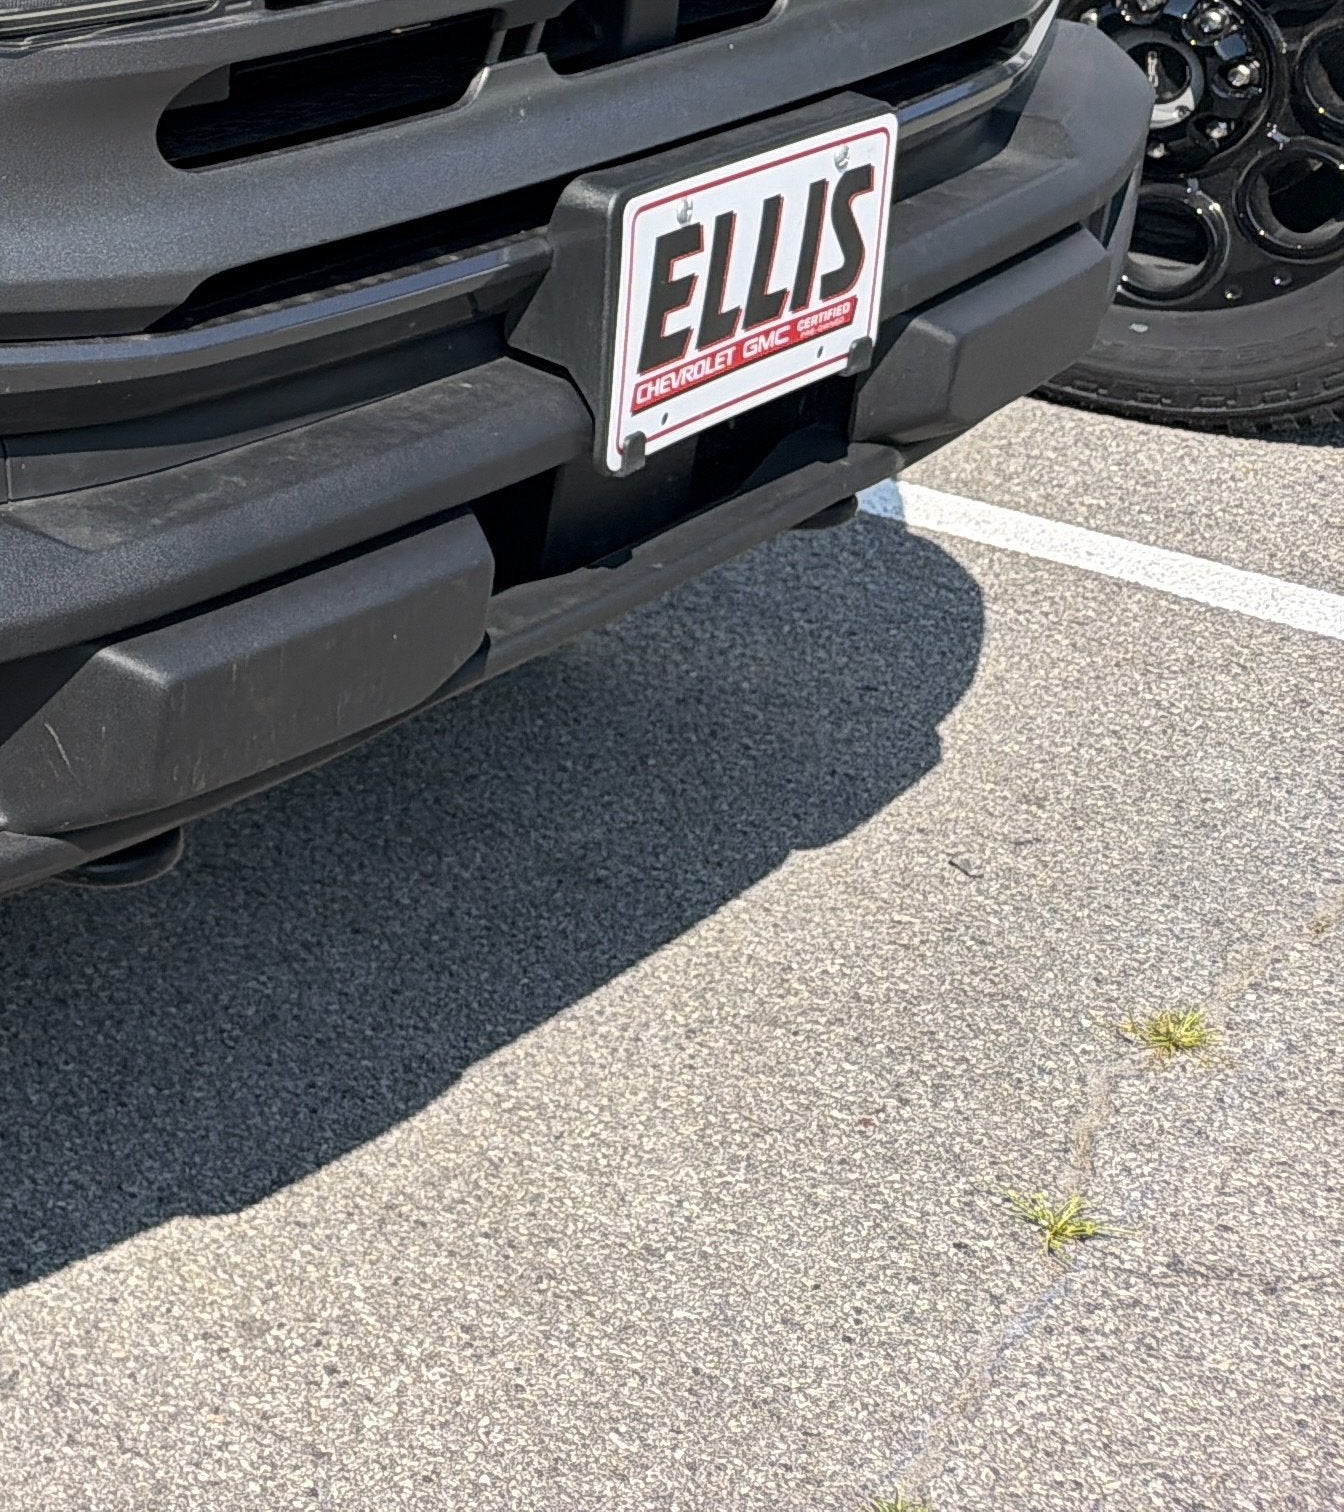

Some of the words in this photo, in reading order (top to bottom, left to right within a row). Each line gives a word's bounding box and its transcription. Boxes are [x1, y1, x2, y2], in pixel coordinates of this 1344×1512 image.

[637, 163, 876, 375] ELLIS
[636, 346, 736, 405] CHEVROLET
[742, 325, 792, 359] GMC
[797, 302, 851, 332] CERTIFIED
